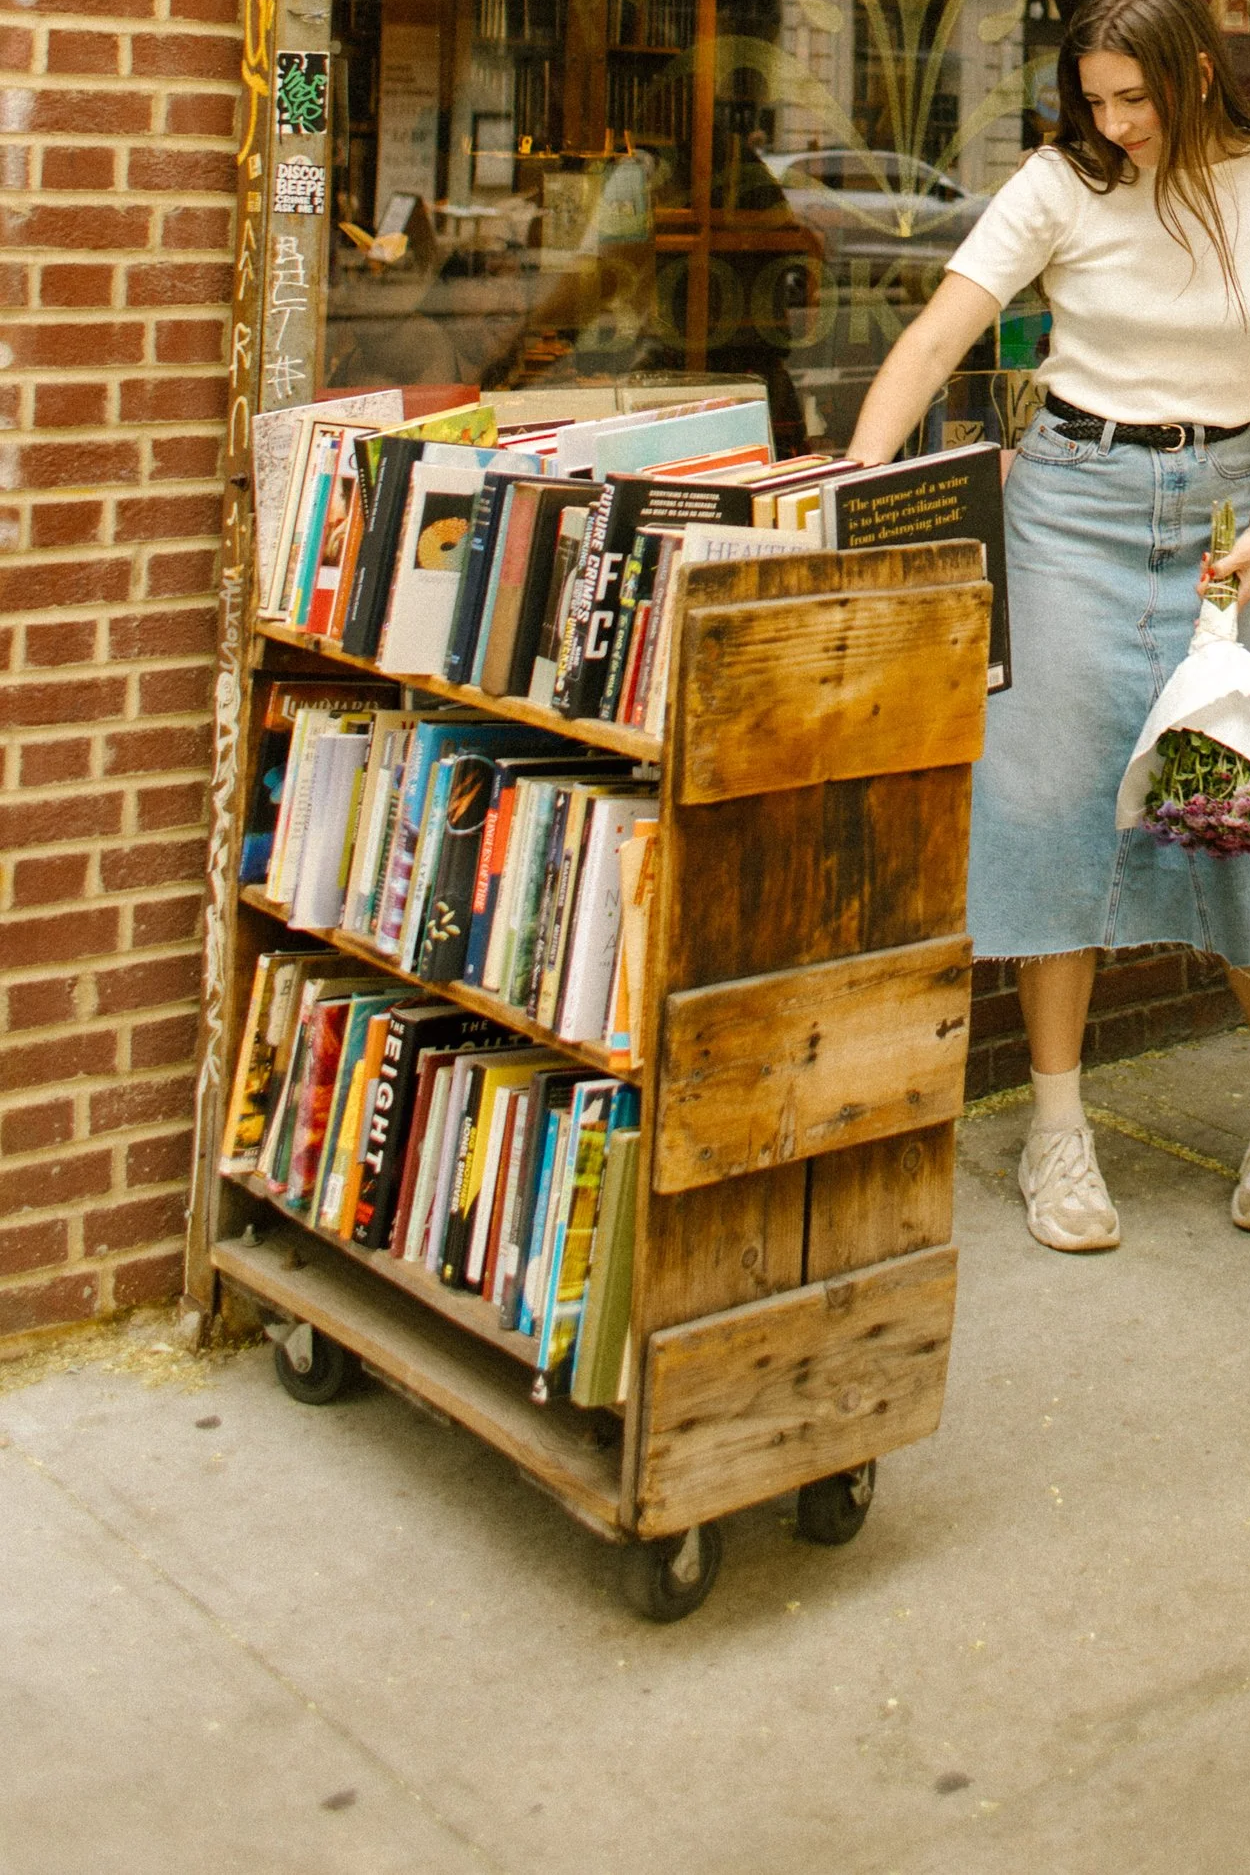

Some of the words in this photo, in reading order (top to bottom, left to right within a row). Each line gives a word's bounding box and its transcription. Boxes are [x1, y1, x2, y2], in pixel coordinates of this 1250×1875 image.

[849, 517, 860, 530] is
[861, 514, 873, 528] to
[874, 507, 900, 528] keep
[901, 493, 958, 518] civilization
[872, 491, 914, 513] purpose
[915, 484, 928, 499] of
[938, 475, 970, 493] writer
[590, 482, 616, 551] FUTURE
[850, 530, 876, 548] from
[878, 520, 932, 542] destroying
[576, 553, 601, 623] CRIMES
[484, 812, 500, 866] TONGUES
[480, 867, 492, 881] OF
[474, 880, 489, 912] FIRE
[389, 1019, 406, 1036] THE
[462, 1019, 489, 1033] THE
[365, 1034, 403, 1175] EIGHT
[459, 1116, 473, 1159] LIONEL
[449, 1161, 466, 1214] SHRIVER
